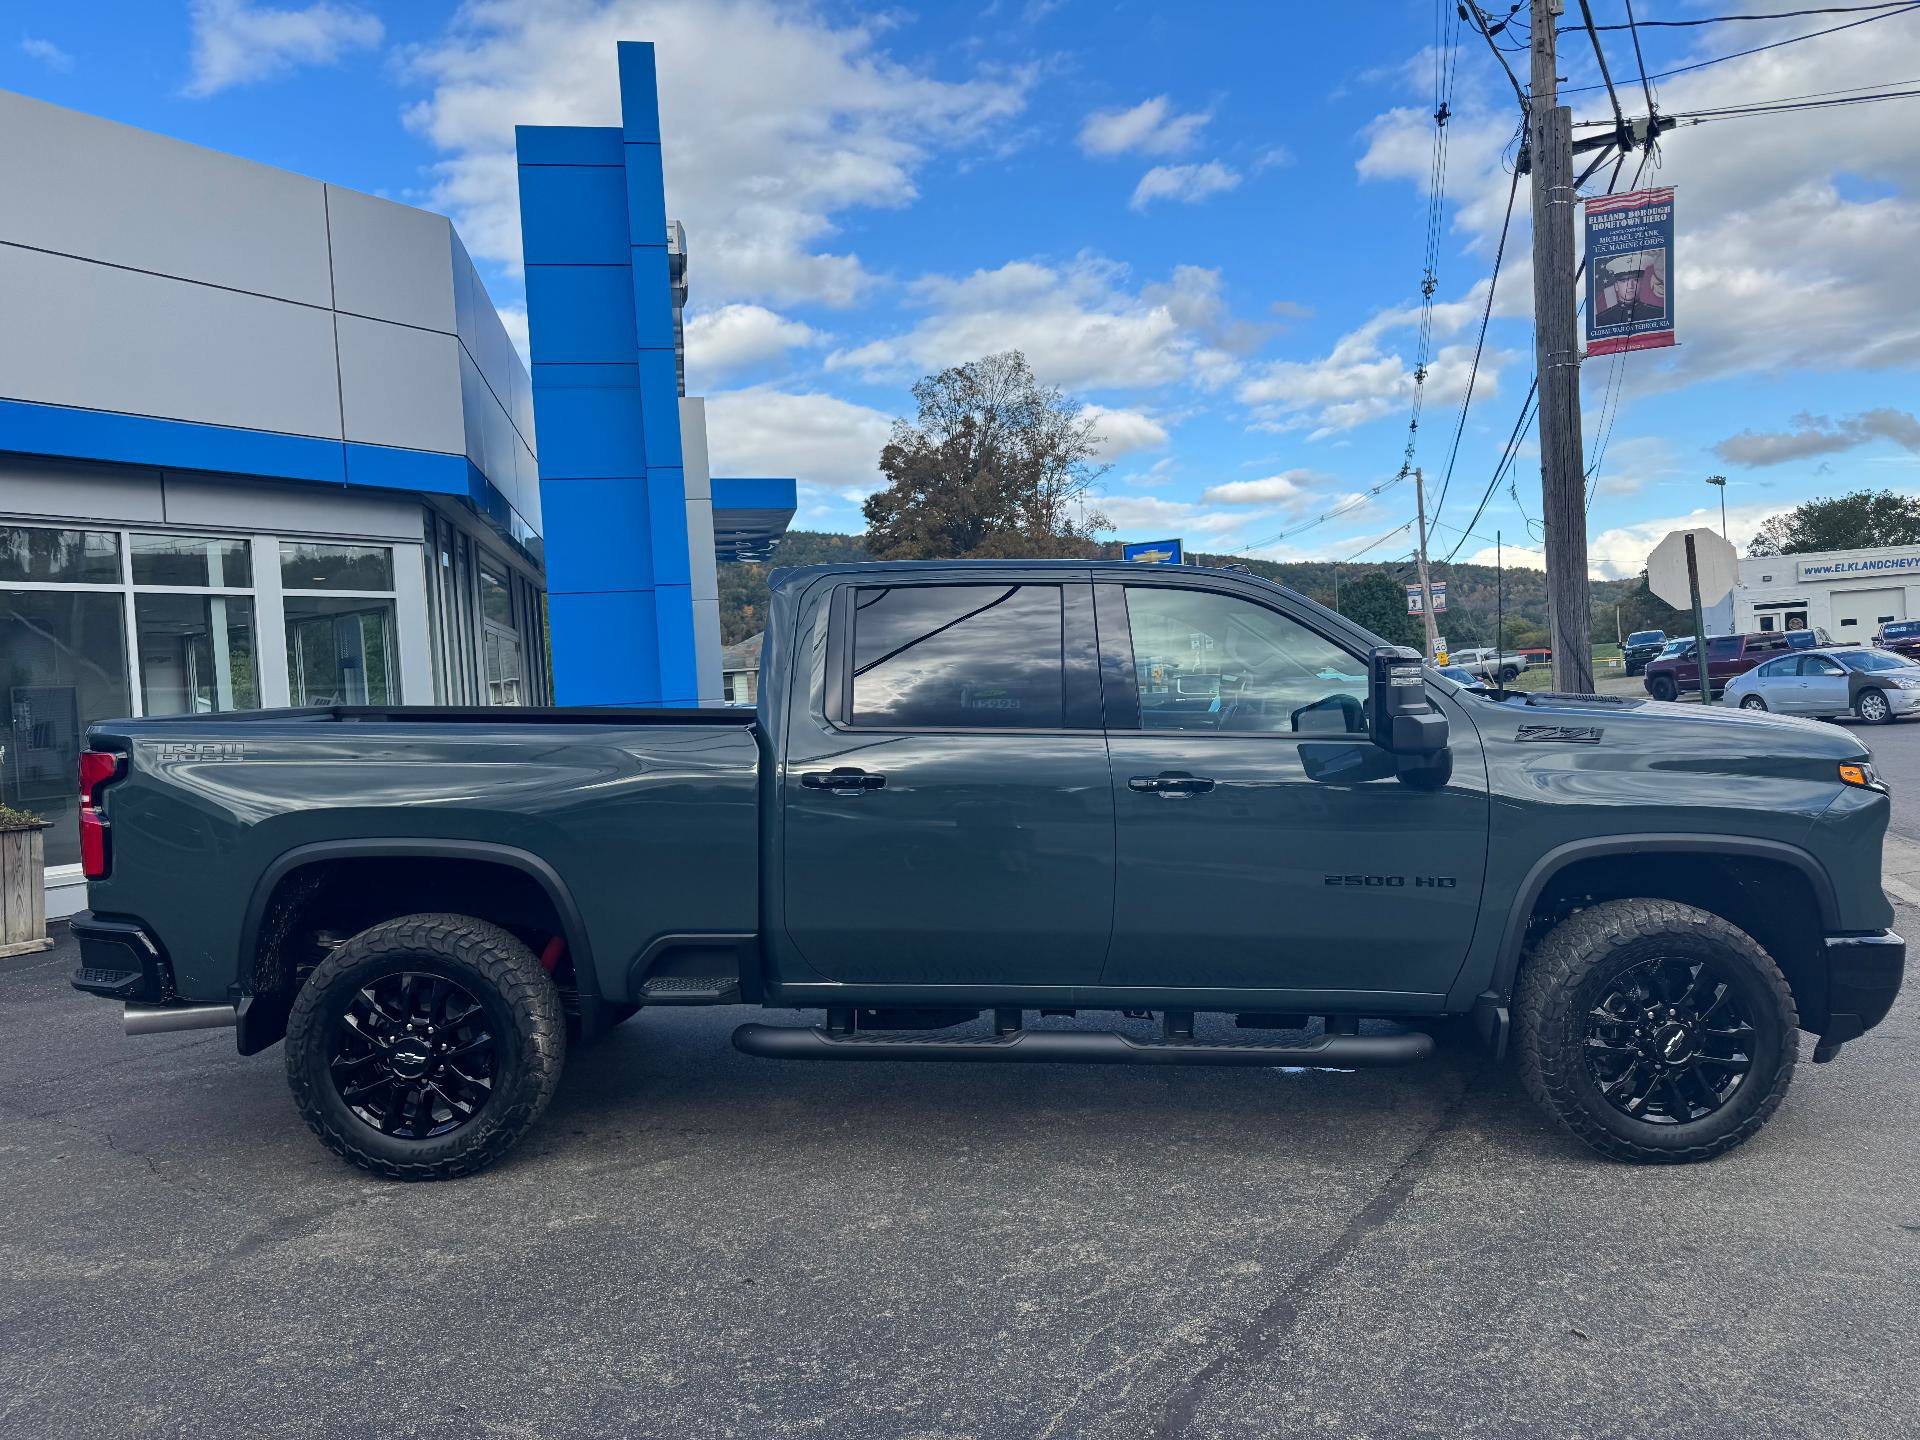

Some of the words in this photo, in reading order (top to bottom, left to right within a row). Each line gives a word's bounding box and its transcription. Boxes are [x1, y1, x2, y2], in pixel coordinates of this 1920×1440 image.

[1588, 212, 1626, 225] ELKLAND
[1628, 206, 1671, 219] BOROUGH
[1592, 218, 1640, 231] HOMETOWN
[1643, 213, 1667, 224] HERO
[1599, 234, 1633, 244] MICHAEL
[1634, 229, 1659, 239] PLANK
[1609, 241, 1639, 251] MARINE
[1640, 237, 1665, 246] CORPS
[142, 743, 258, 754] TRAIL
[156, 754, 244, 762] BOSS
[1324, 875, 1404, 887] 2500
[1415, 876, 1457, 888] HD
